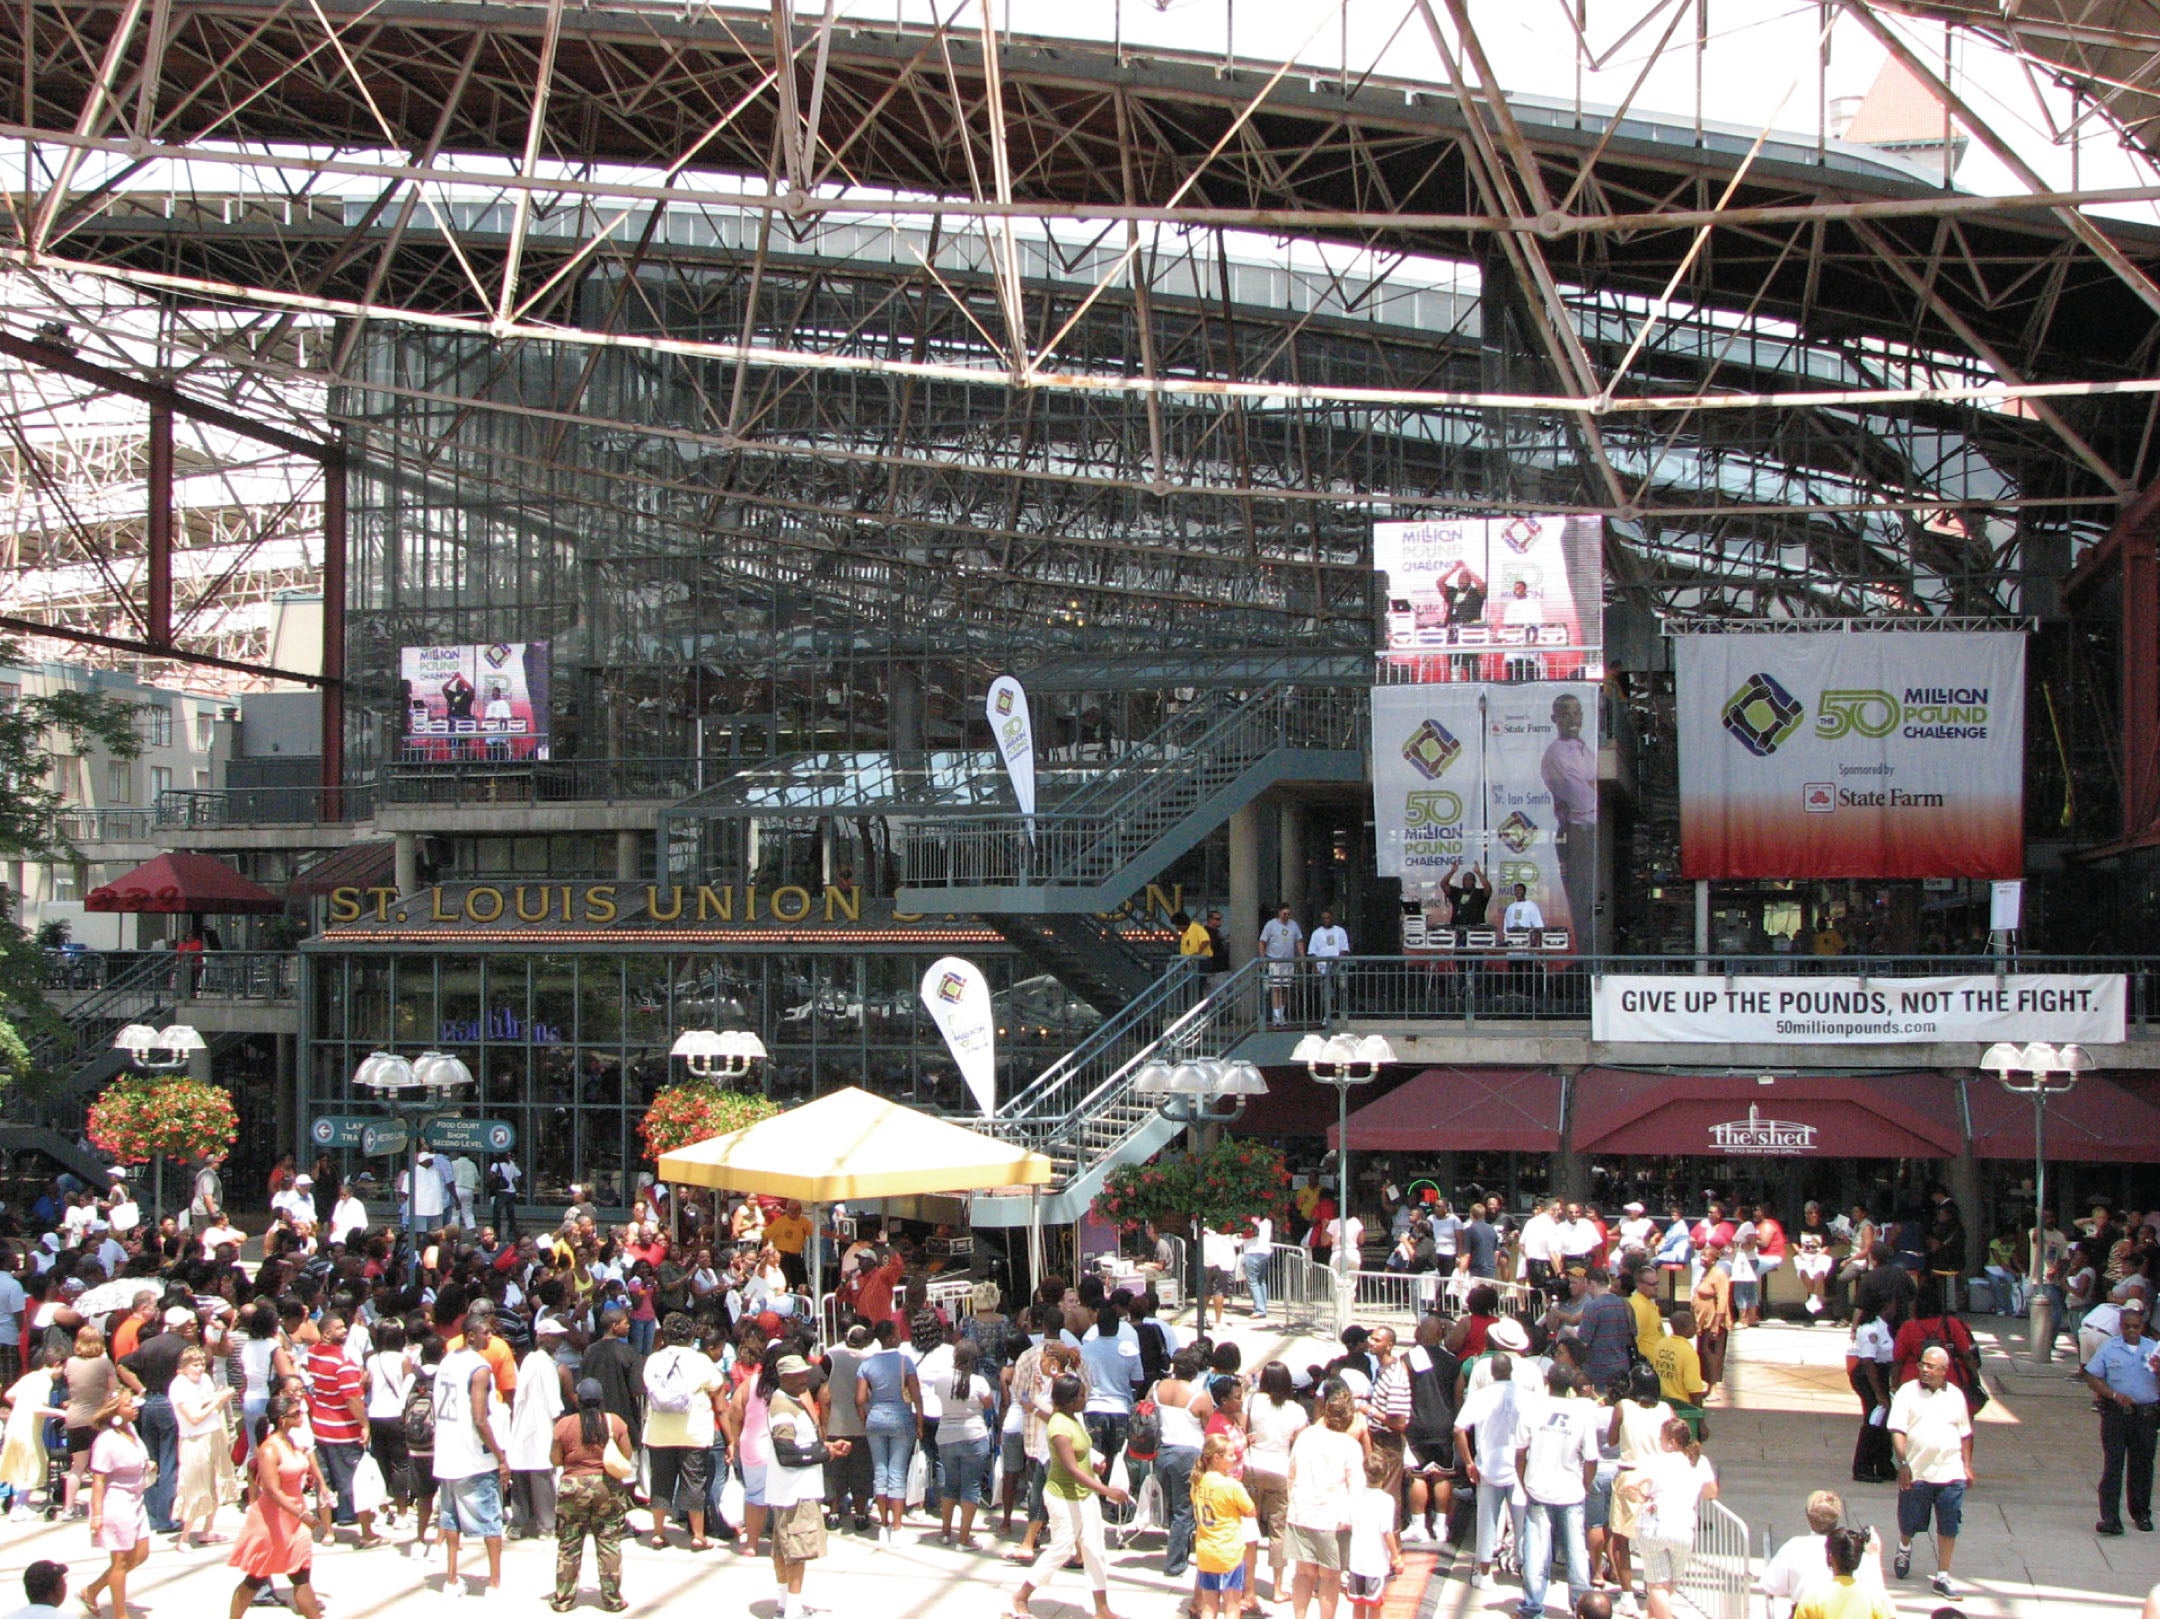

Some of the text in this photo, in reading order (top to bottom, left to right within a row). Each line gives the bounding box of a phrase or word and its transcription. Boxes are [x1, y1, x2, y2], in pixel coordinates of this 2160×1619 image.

[1904, 688, 1988, 705] MILLION
[1815, 690, 1900, 740] 50
[1820, 717, 1834, 725] THE
[1904, 706, 1988, 724] POUND
[1904, 725, 1988, 739] CHALLENGE
[1839, 763, 1895, 777] Sponsored by
[1526, 792, 1551, 805] Smith
[1838, 788, 1944, 808] State Farm
[1405, 790, 1463, 828] 50
[1405, 823, 1463, 840] MILLION
[1404, 841, 1463, 855] POUND
[330, 886, 408, 923] ST.
[431, 886, 618, 923] LOUIS
[646, 884, 862, 923] UNION
[1621, 989, 2099, 1017] GIVE UP THE POUNDS, NOT THE FIGHT.
[1776, 1020, 1936, 1037] 50millionpounds.com
[457, 1121, 480, 1129] COURT
[1715, 1121, 1811, 1146] the shed
[432, 1139, 460, 1147] SECOND
